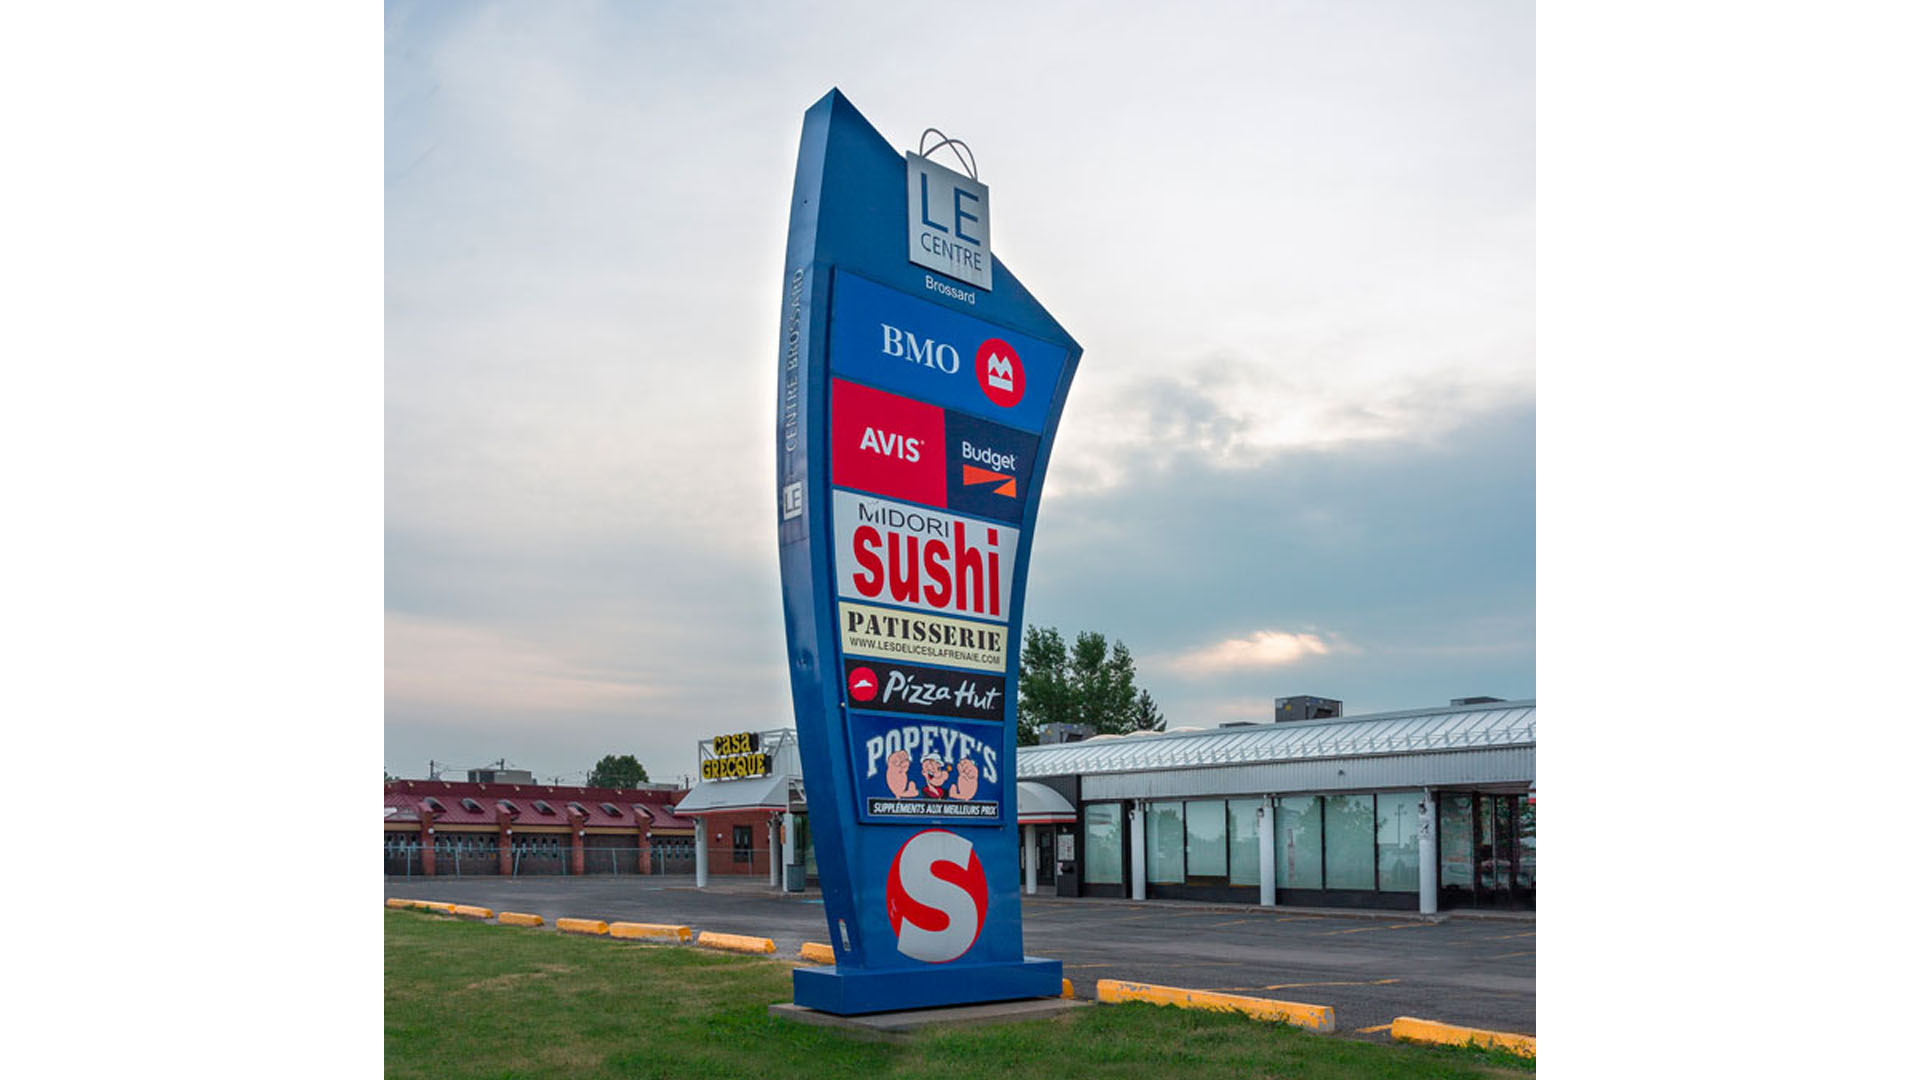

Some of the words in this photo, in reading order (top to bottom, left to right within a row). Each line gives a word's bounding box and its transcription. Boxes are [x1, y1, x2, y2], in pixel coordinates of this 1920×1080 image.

[920, 171, 981, 246] LE
[920, 232, 982, 272] CENTRE
[925, 275, 975, 305] Brossard
[881, 323, 960, 374] BMO
[860, 427, 920, 463] AVIS
[962, 441, 1016, 471] Budget
[859, 502, 949, 538] MIDORI
[852, 520, 1000, 616] sushi
[848, 611, 1001, 652] PATISSERIE
[882, 670, 952, 706] Pizza
[954, 680, 1002, 710] Hut
[703, 754, 766, 779] GRECQUE
[897, 831, 978, 963] S
